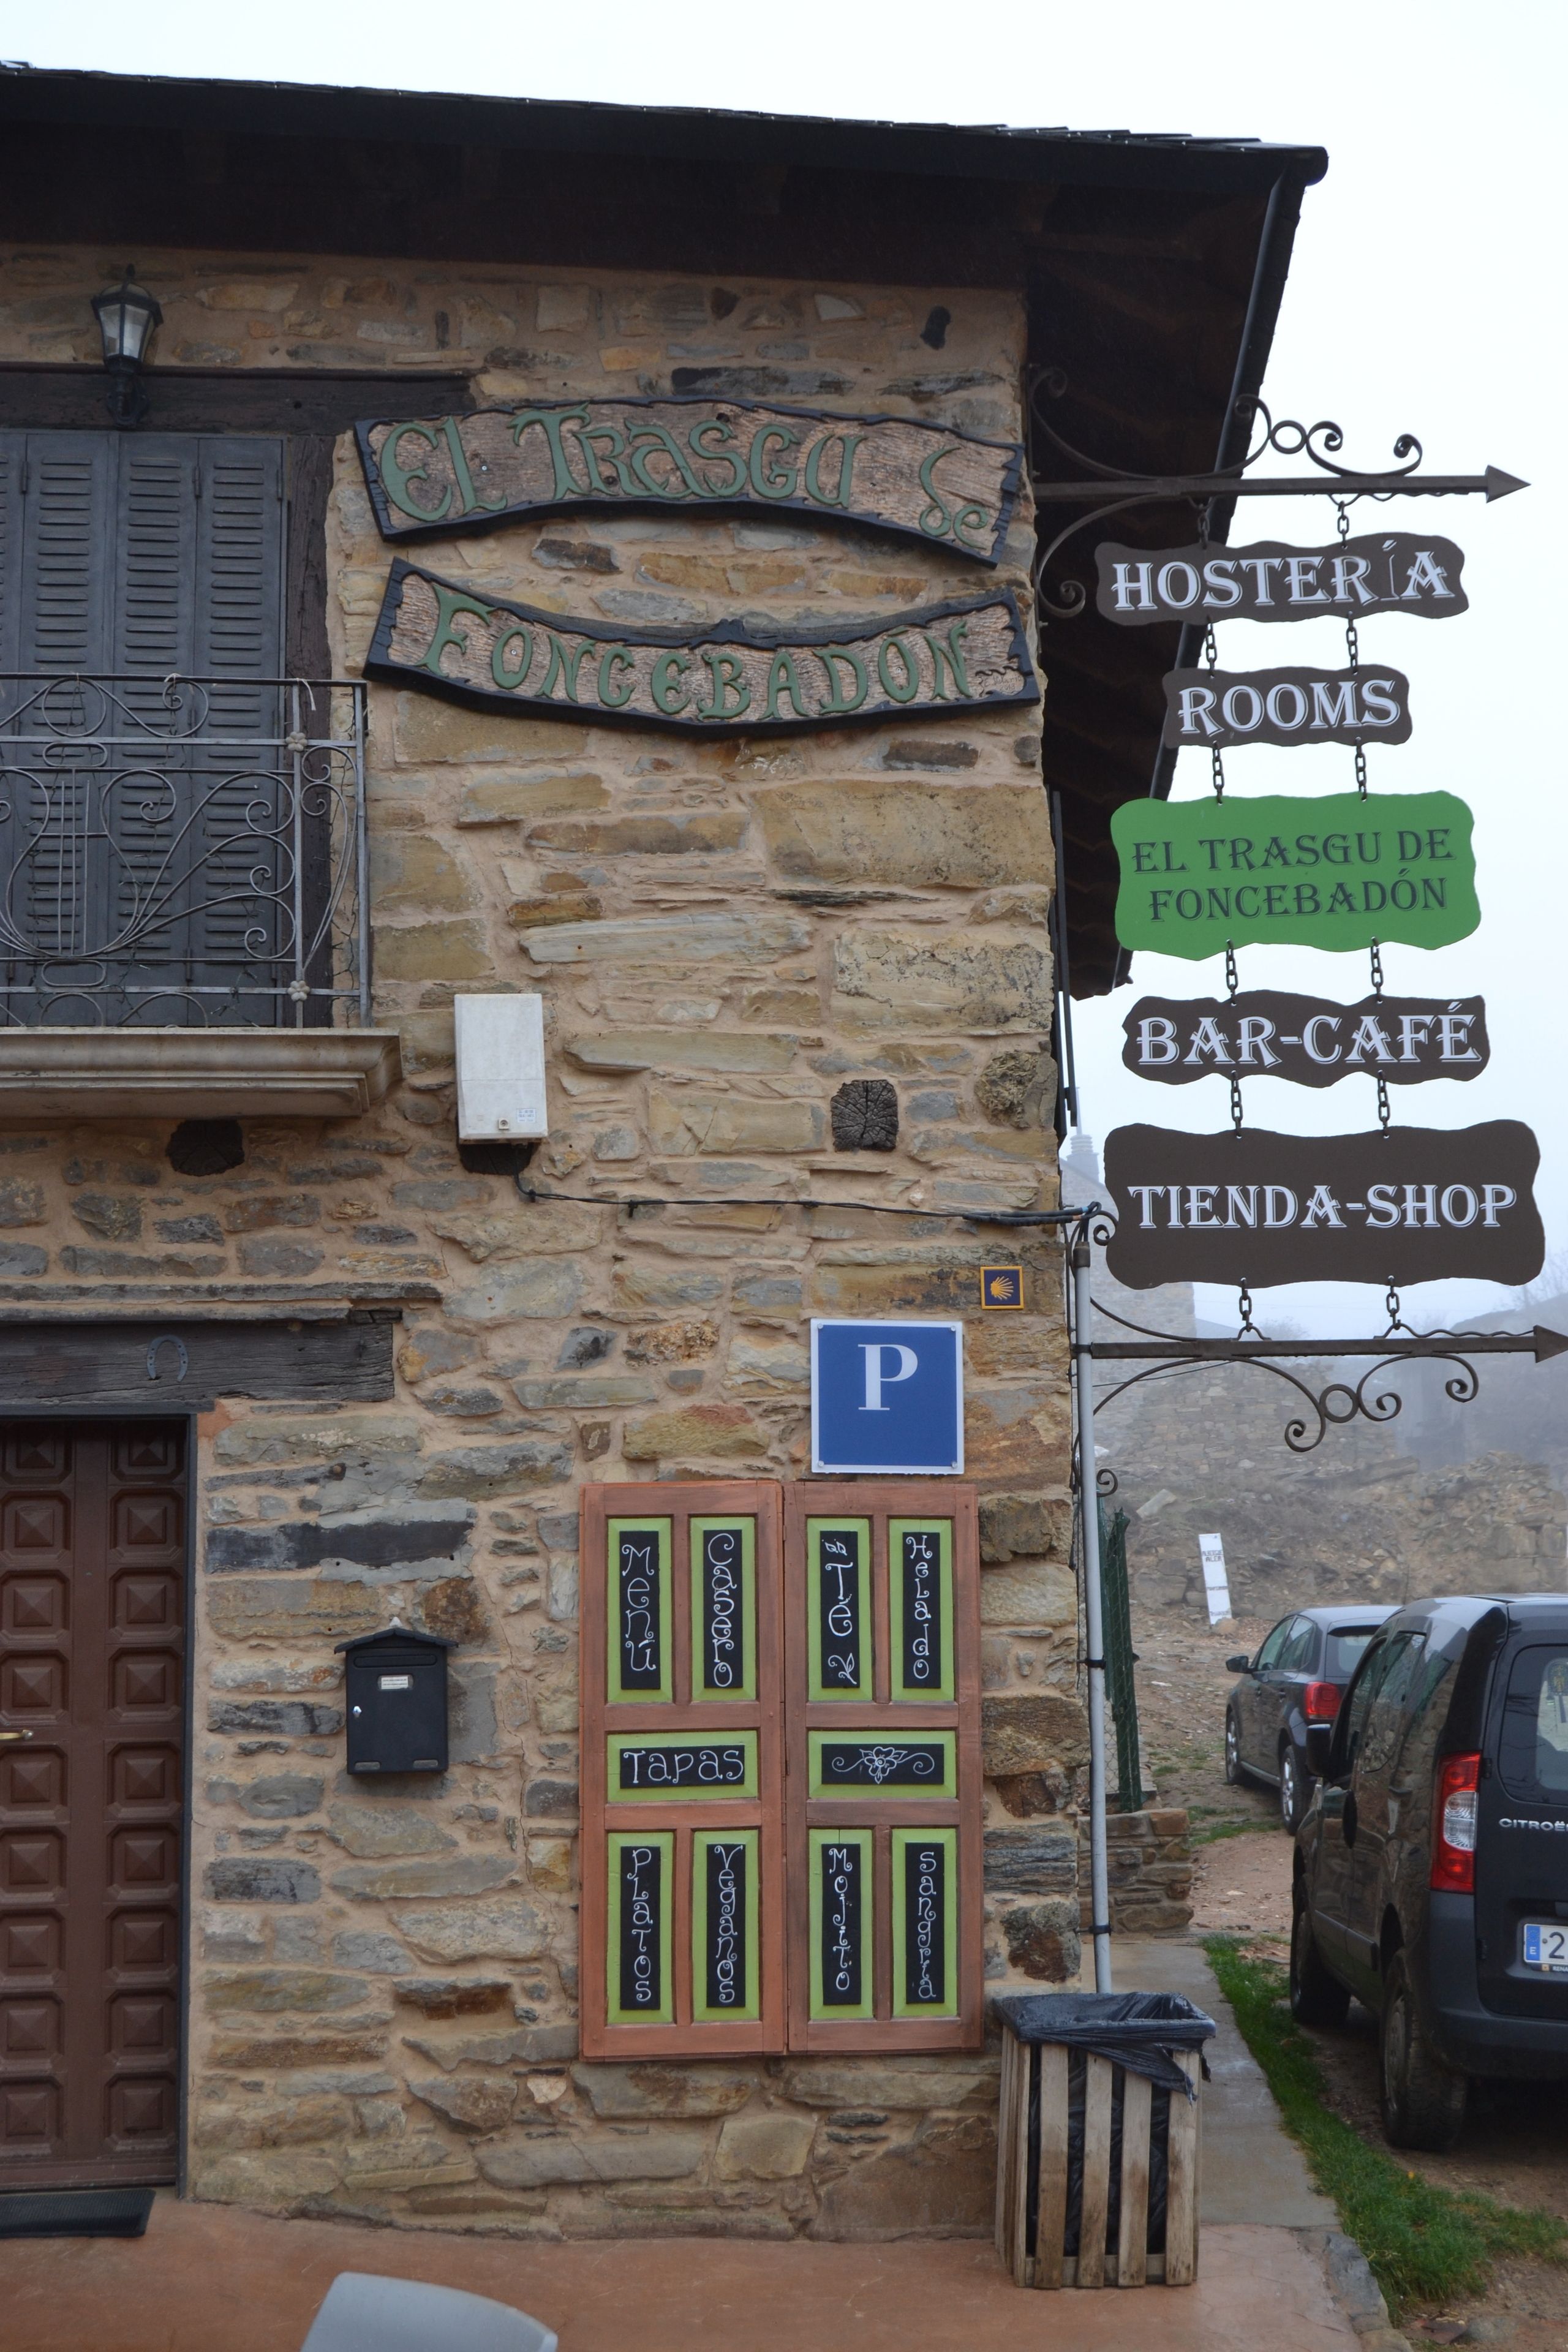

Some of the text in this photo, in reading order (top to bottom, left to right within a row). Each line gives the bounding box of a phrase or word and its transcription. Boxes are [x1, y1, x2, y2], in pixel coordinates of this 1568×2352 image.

[1112, 540, 1456, 611] HOSTERÍA
[1178, 679, 1401, 736] ROOMS
[1132, 828, 1457, 874] EL TRASGU DE
[1149, 867, 1447, 922] FONCEBADÓN
[1136, 1000, 1482, 1068] BAR-CAFÉ
[1127, 1183, 1517, 1230] TIENDA-SHOP
[858, 1344, 918, 1411] P
[621, 1532, 737, 1687] Menú Casero
[1499, 1818, 1568, 1832] CITROË
[714, 1845, 744, 2003] Veganos
[1548, 1931, 1565, 1959] 2
